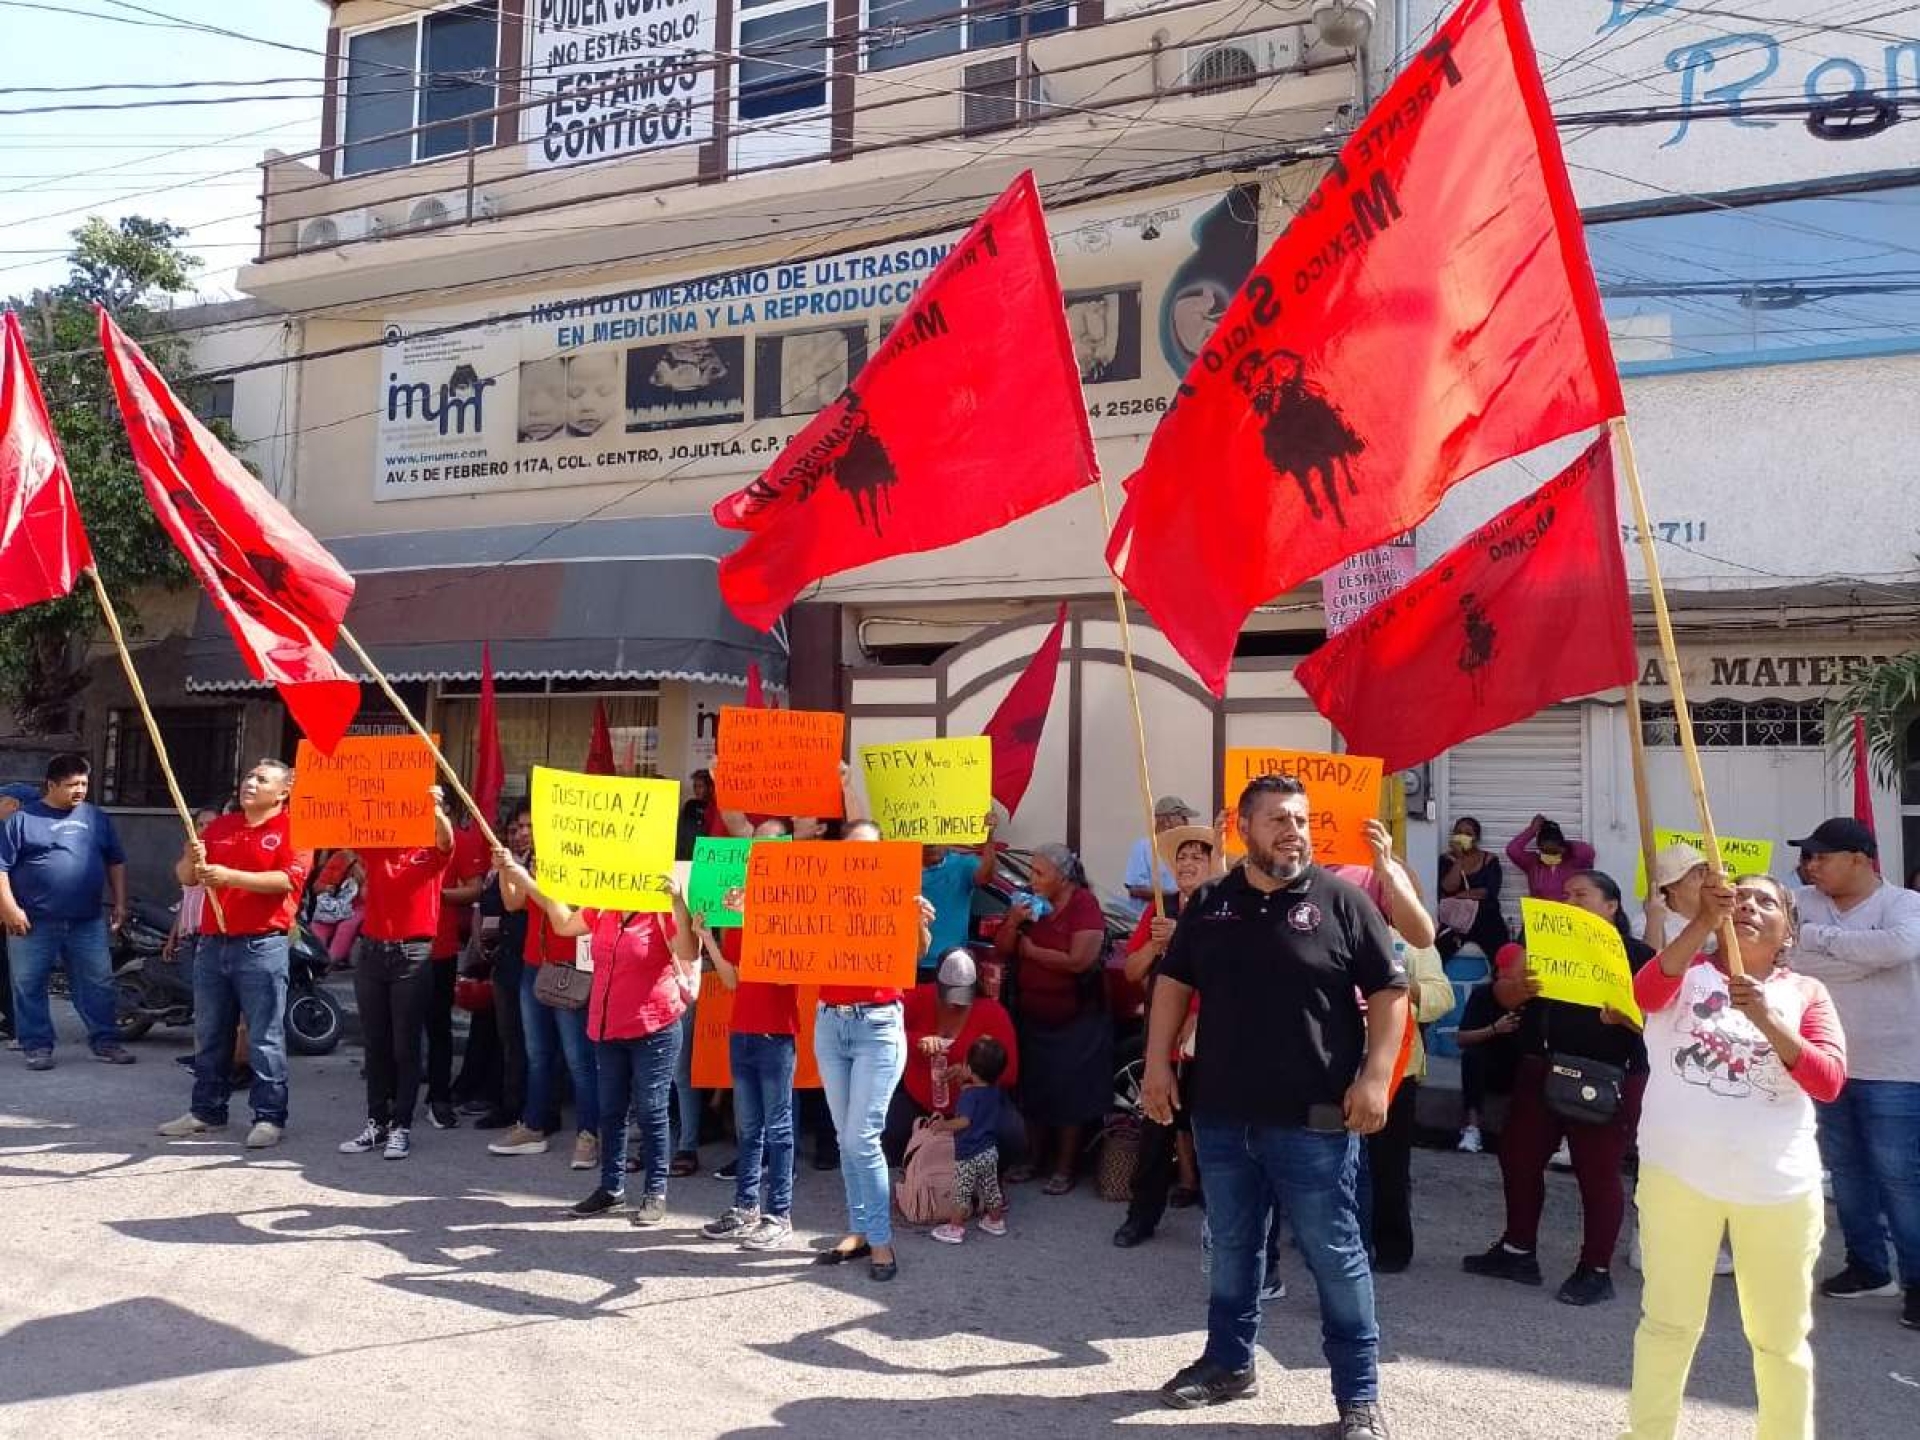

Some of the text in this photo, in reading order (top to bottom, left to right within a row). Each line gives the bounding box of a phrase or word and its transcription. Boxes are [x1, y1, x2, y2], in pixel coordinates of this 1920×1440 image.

[585, 27, 641, 63] ESTAS
[648, 11, 699, 48] SOLO!
[543, 97, 693, 162] CONTIGO!
[530, 291, 644, 324] INSTITUTO
[650, 269, 769, 309] MEXICANO
[777, 265, 808, 290] DE
[557, 324, 586, 348] EN
[593, 311, 698, 343] MEDICINA
[706, 306, 722, 329] Y
[728, 302, 756, 326] LA
[410, 470, 419, 483] 5
[423, 467, 441, 481] DE
[444, 461, 508, 481] FEBRERO
[513, 457, 553, 475] 117A,
[557, 455, 591, 470] COL.
[596, 447, 663, 466] CENTRO,
[751, 435, 780, 453] C.P.
[551, 783, 623, 815] JUSTICIA
[551, 813, 617, 838] JUSTICIA
[579, 867, 669, 892] JIMENEZ
[880, 885, 902, 906] SU
